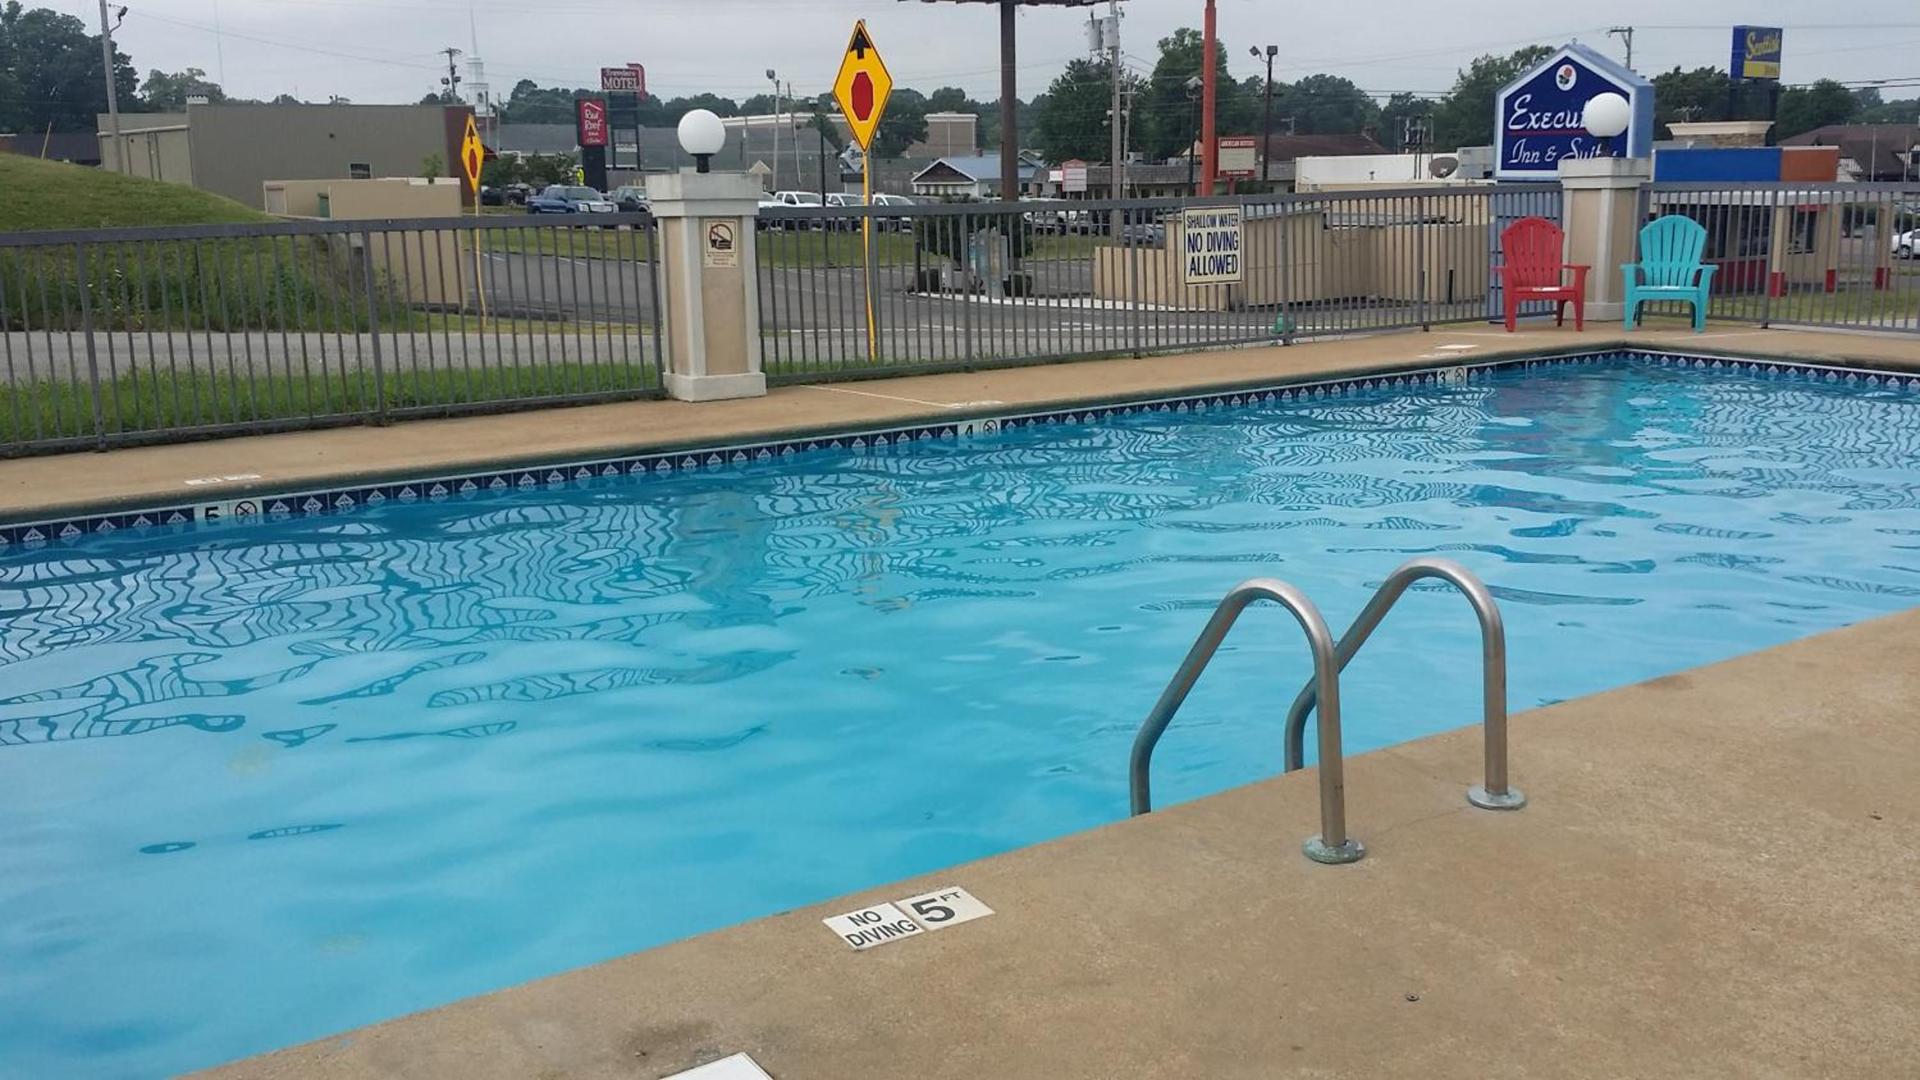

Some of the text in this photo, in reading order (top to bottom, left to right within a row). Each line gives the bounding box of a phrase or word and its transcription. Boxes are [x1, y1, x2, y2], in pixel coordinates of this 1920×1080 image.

[603, 77, 639, 89] MOTEL
[1508, 94, 1588, 129] Execu
[1508, 137, 1617, 163] Inn & Suit
[1187, 213, 1238, 228] SHALLOW WATER
[1187, 231, 1239, 253] NO DIVING
[1189, 254, 1239, 276] ALLOWED
[205, 506, 220, 520] 5
[911, 891, 961, 922] 5 FT
[848, 911, 882, 927] NO
[845, 919, 919, 947] DIVING
